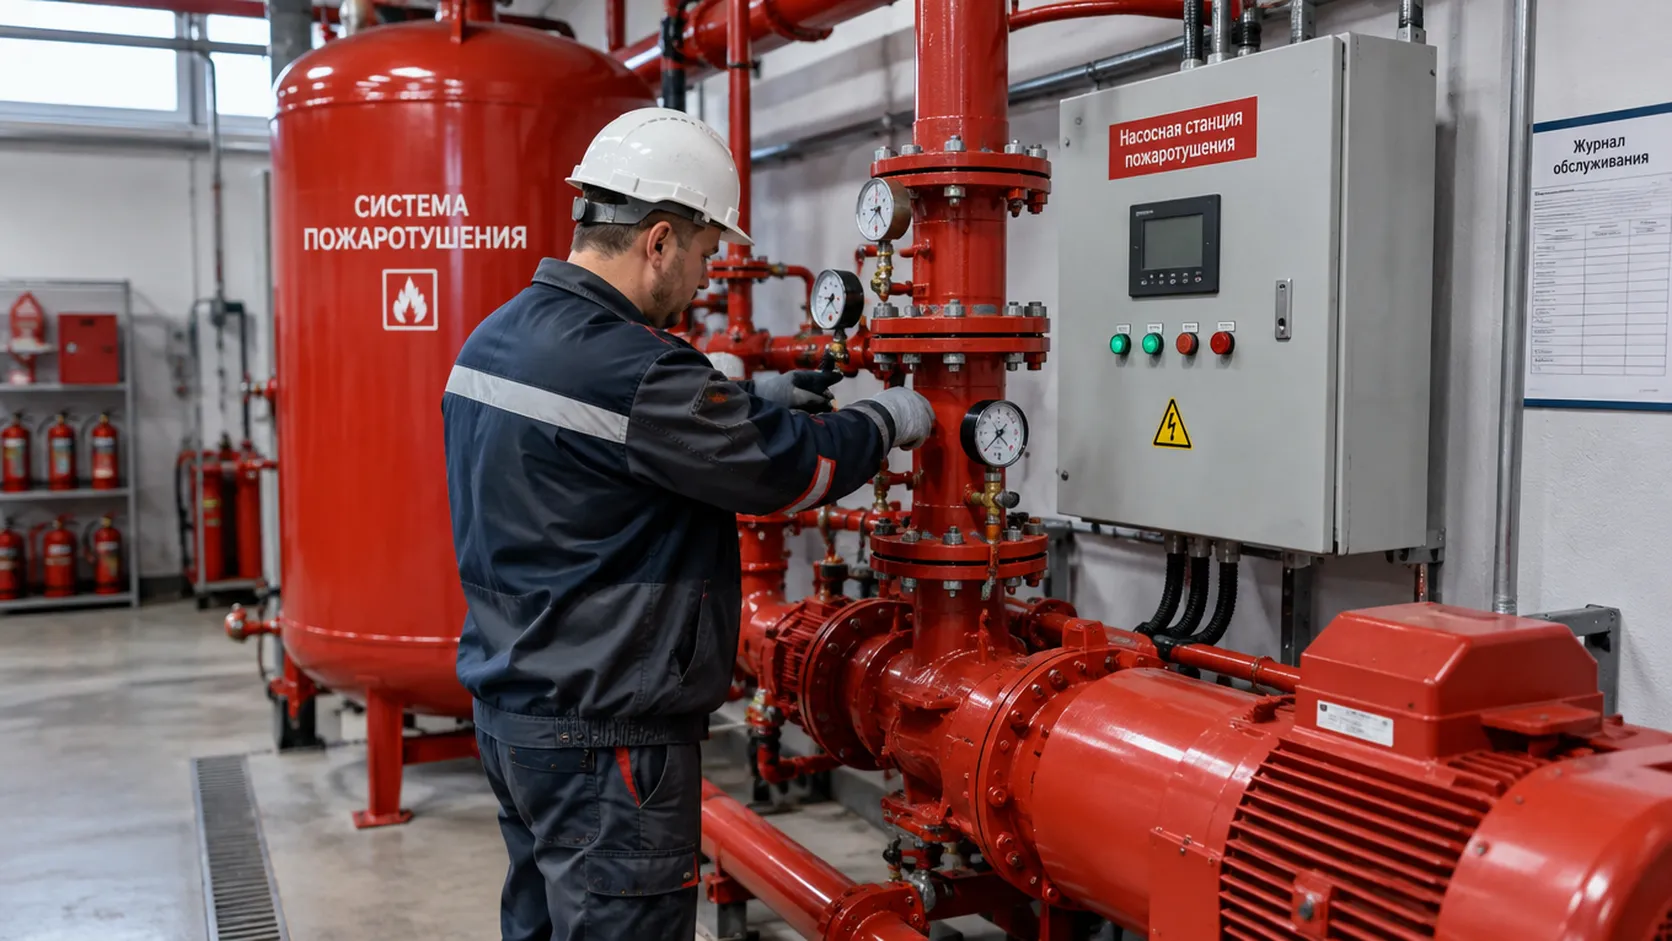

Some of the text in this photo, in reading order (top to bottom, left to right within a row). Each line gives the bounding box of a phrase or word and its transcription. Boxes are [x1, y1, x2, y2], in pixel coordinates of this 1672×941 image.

[1120, 111, 1243, 147] Насосная станция
[1125, 137, 1235, 168] пожаротушения
[1573, 136, 1625, 155] Журнал
[1553, 152, 1649, 175] обслуживания
[354, 194, 469, 218] СИСТЕМА
[303, 226, 528, 251] ПОЖАРОТУШЕНИЯ
